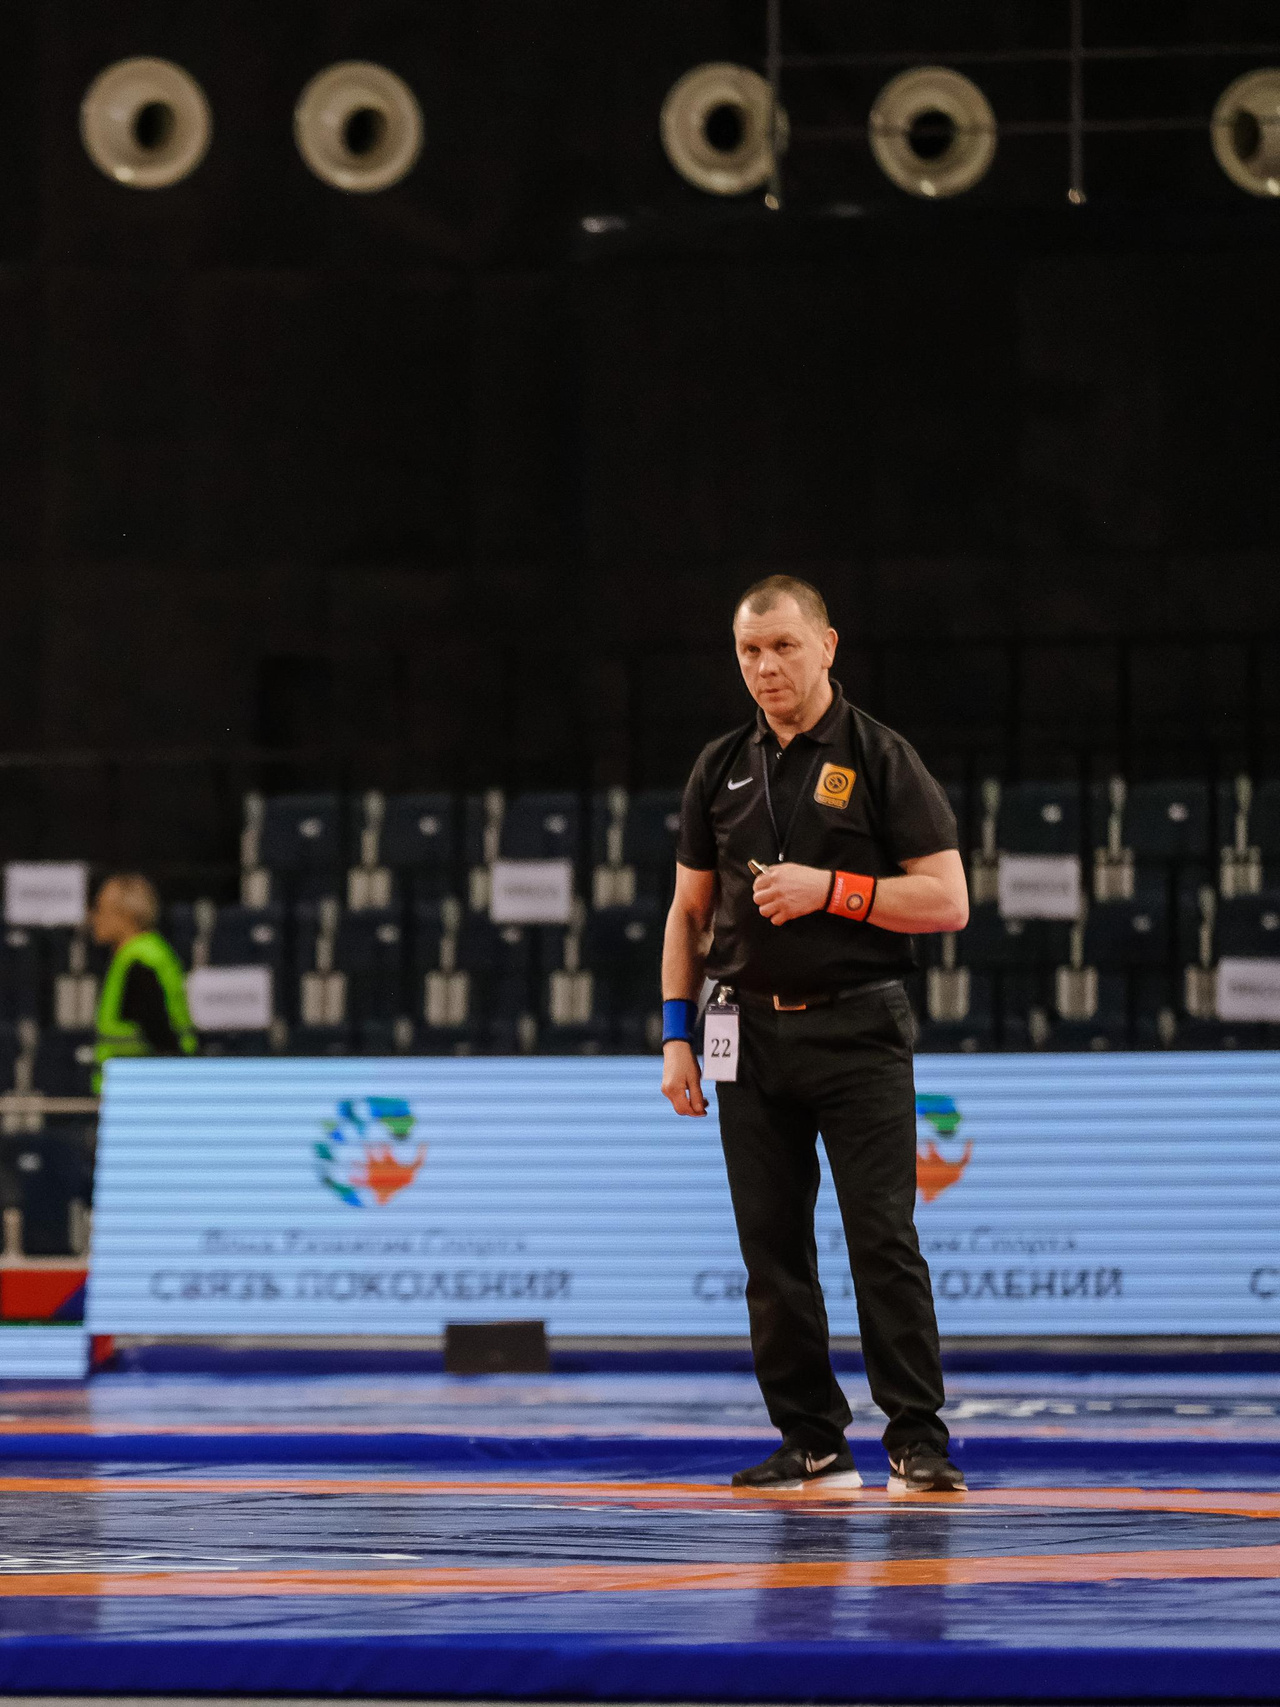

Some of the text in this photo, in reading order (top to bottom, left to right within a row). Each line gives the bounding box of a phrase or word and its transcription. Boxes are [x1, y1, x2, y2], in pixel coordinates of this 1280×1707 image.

[711, 1038, 731, 1058] 22
[150, 1267, 573, 1303] СВЯЗЬ ПОКОЛЕНИЙ
